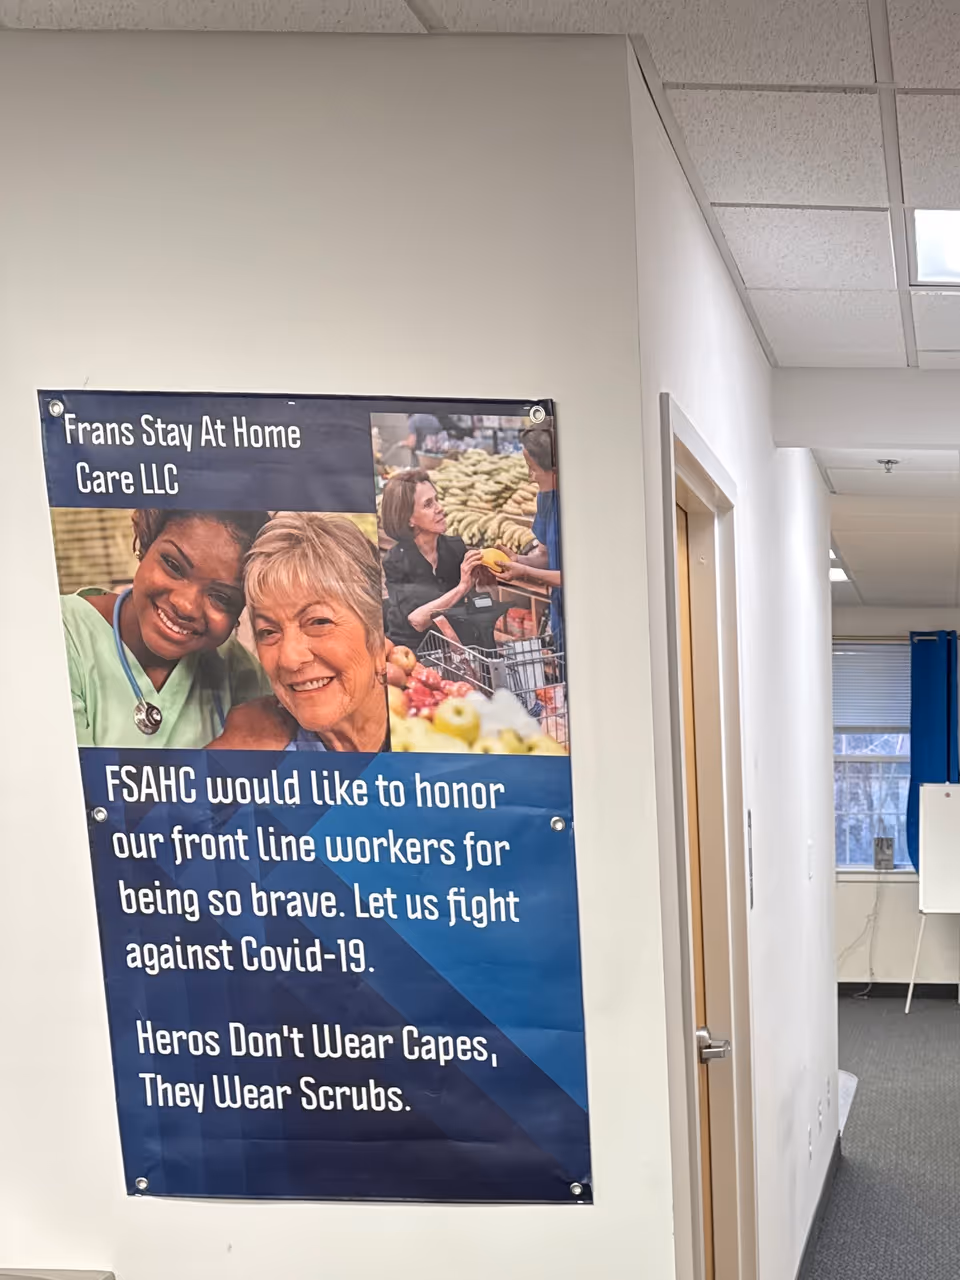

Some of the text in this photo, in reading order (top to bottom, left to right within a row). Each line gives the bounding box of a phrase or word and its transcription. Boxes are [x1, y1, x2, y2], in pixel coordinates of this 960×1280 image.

[65, 413, 301, 453] Frans Stay At Home
[77, 461, 179, 494] Care LLC
[105, 765, 505, 809] FSAHC would like to honor
[112, 826, 510, 872] our front line workers for
[118, 880, 520, 928] being so brave. Let us fight
[125, 935, 376, 975] against Covid-19.
[136, 1020, 498, 1068] Heros Don't Wear Capes,
[138, 1072, 412, 1114] They Wear Scrubs.
